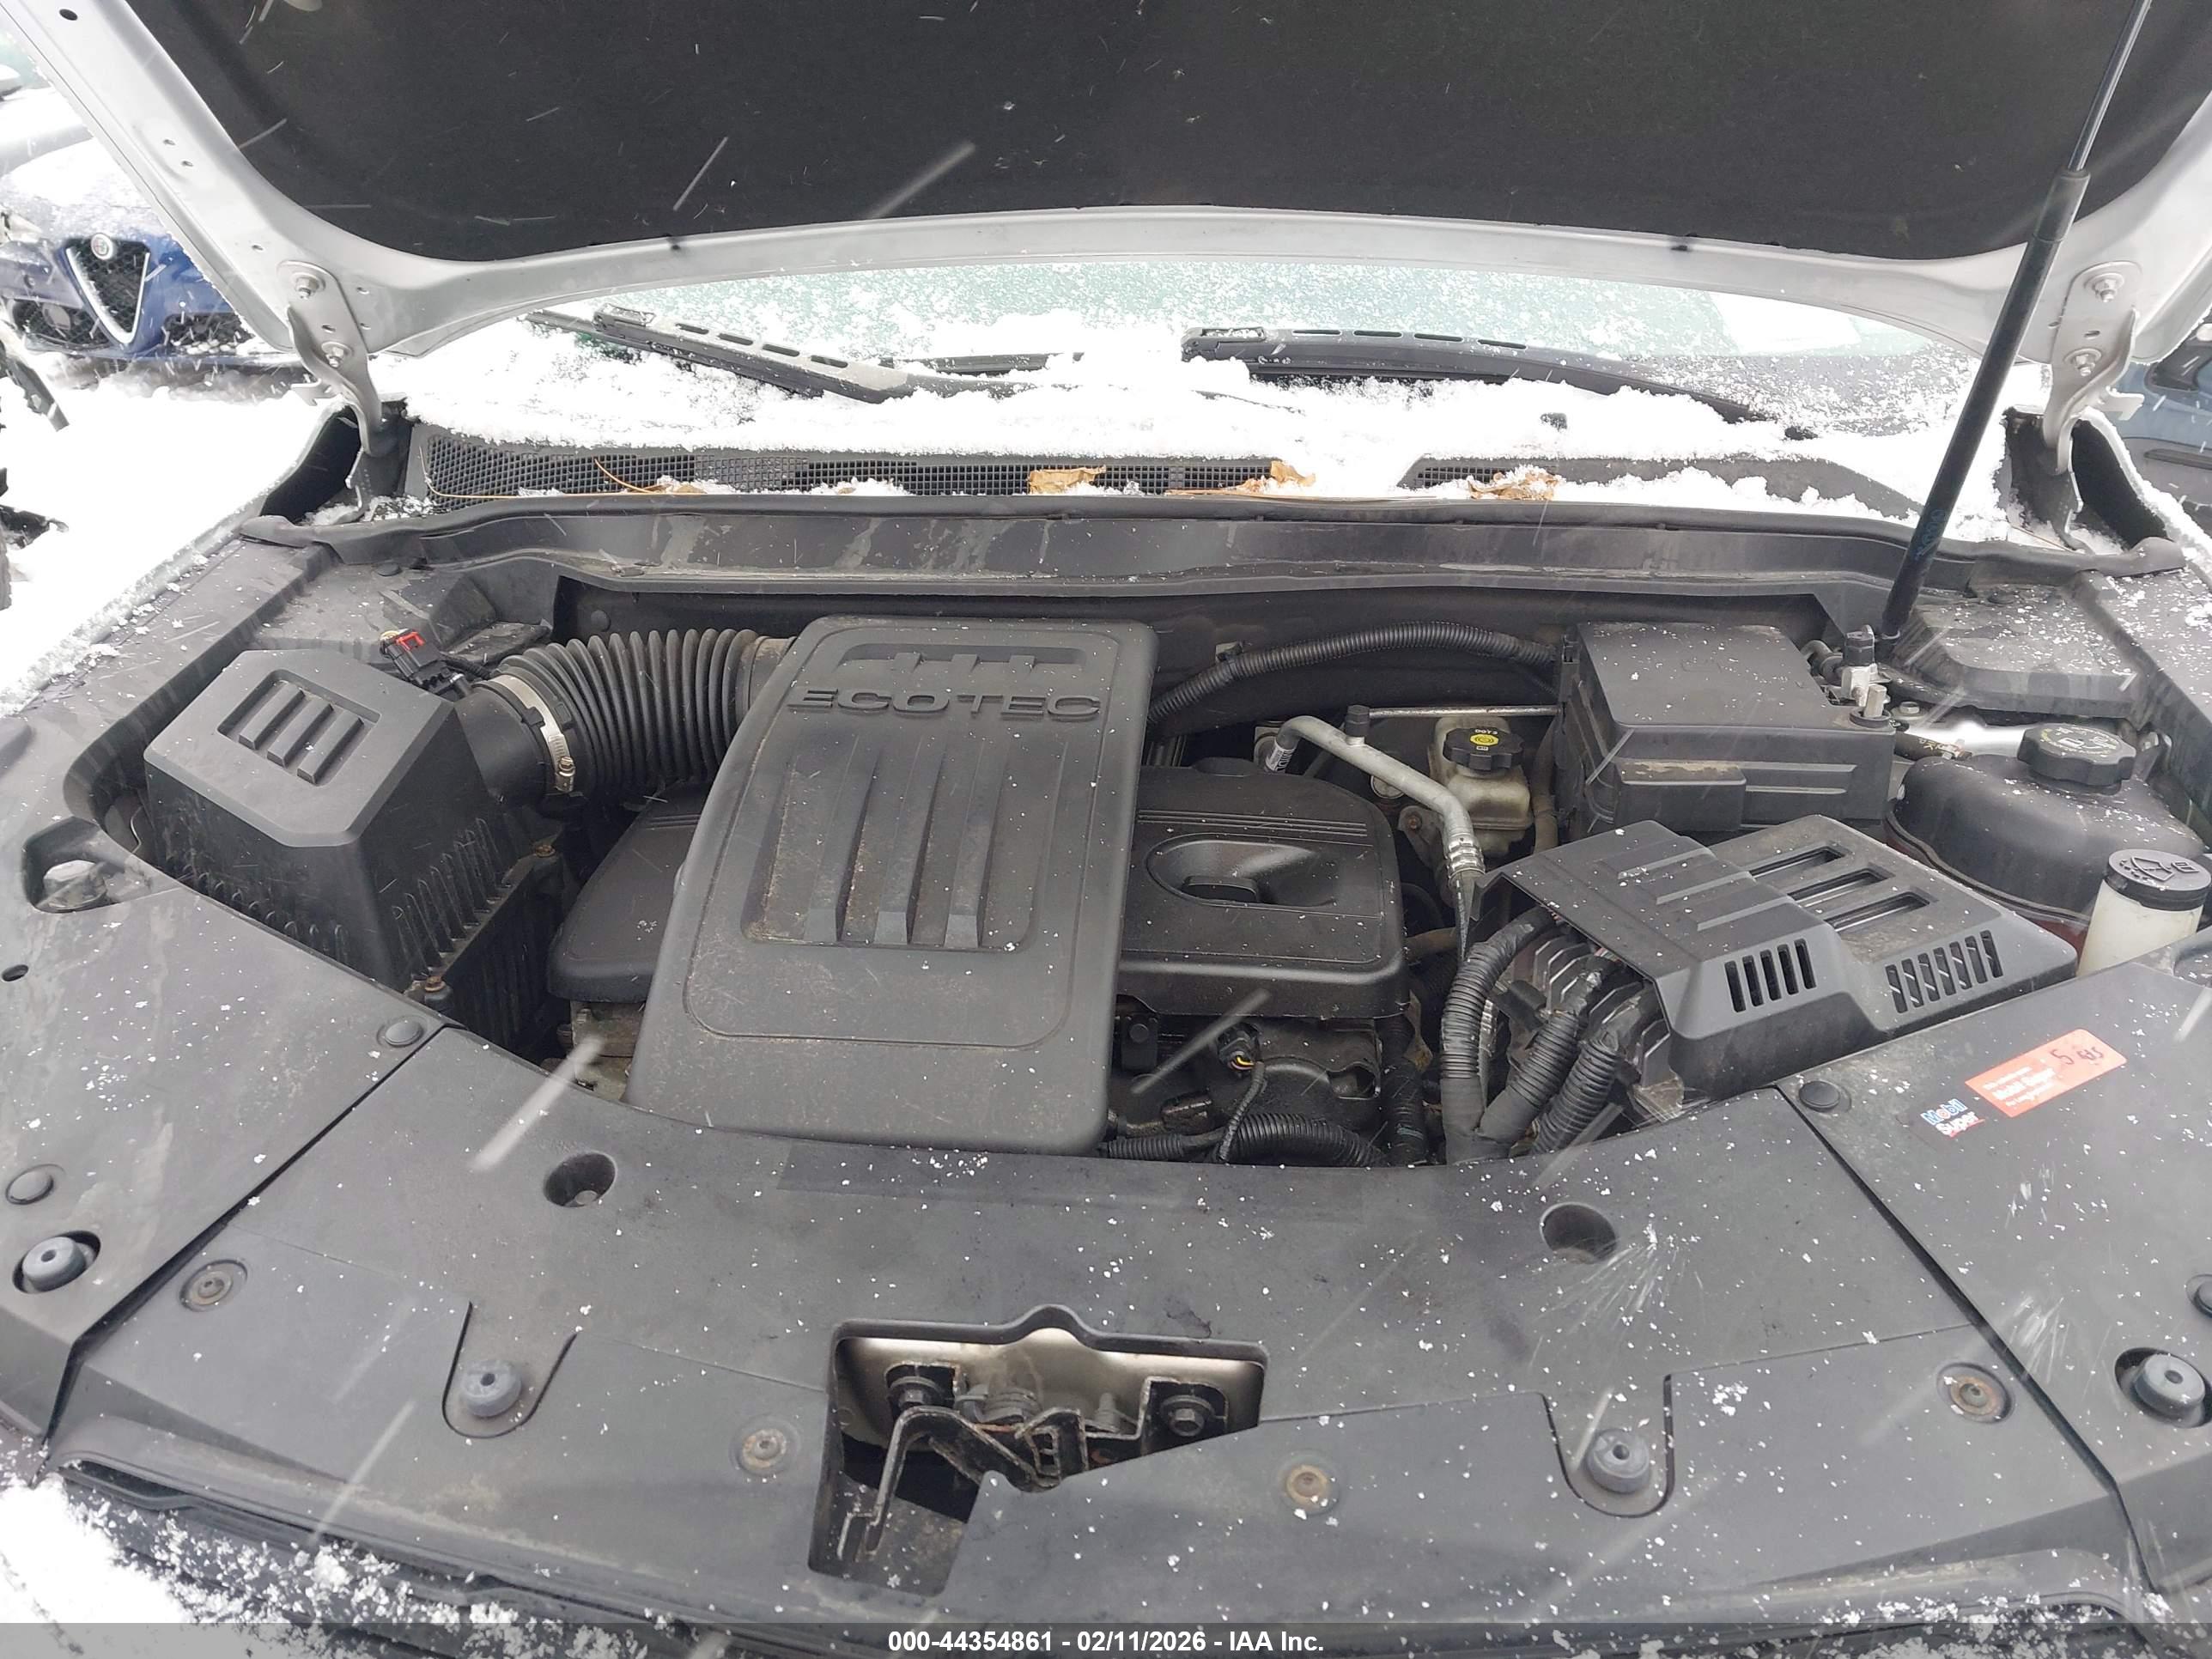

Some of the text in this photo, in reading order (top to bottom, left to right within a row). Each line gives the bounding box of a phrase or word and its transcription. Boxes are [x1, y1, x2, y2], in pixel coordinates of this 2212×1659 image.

[787, 688, 1101, 722] ECOTEC
[1919, 1098, 1968, 1126] Mobil
[1935, 1111, 1979, 1138] Super
